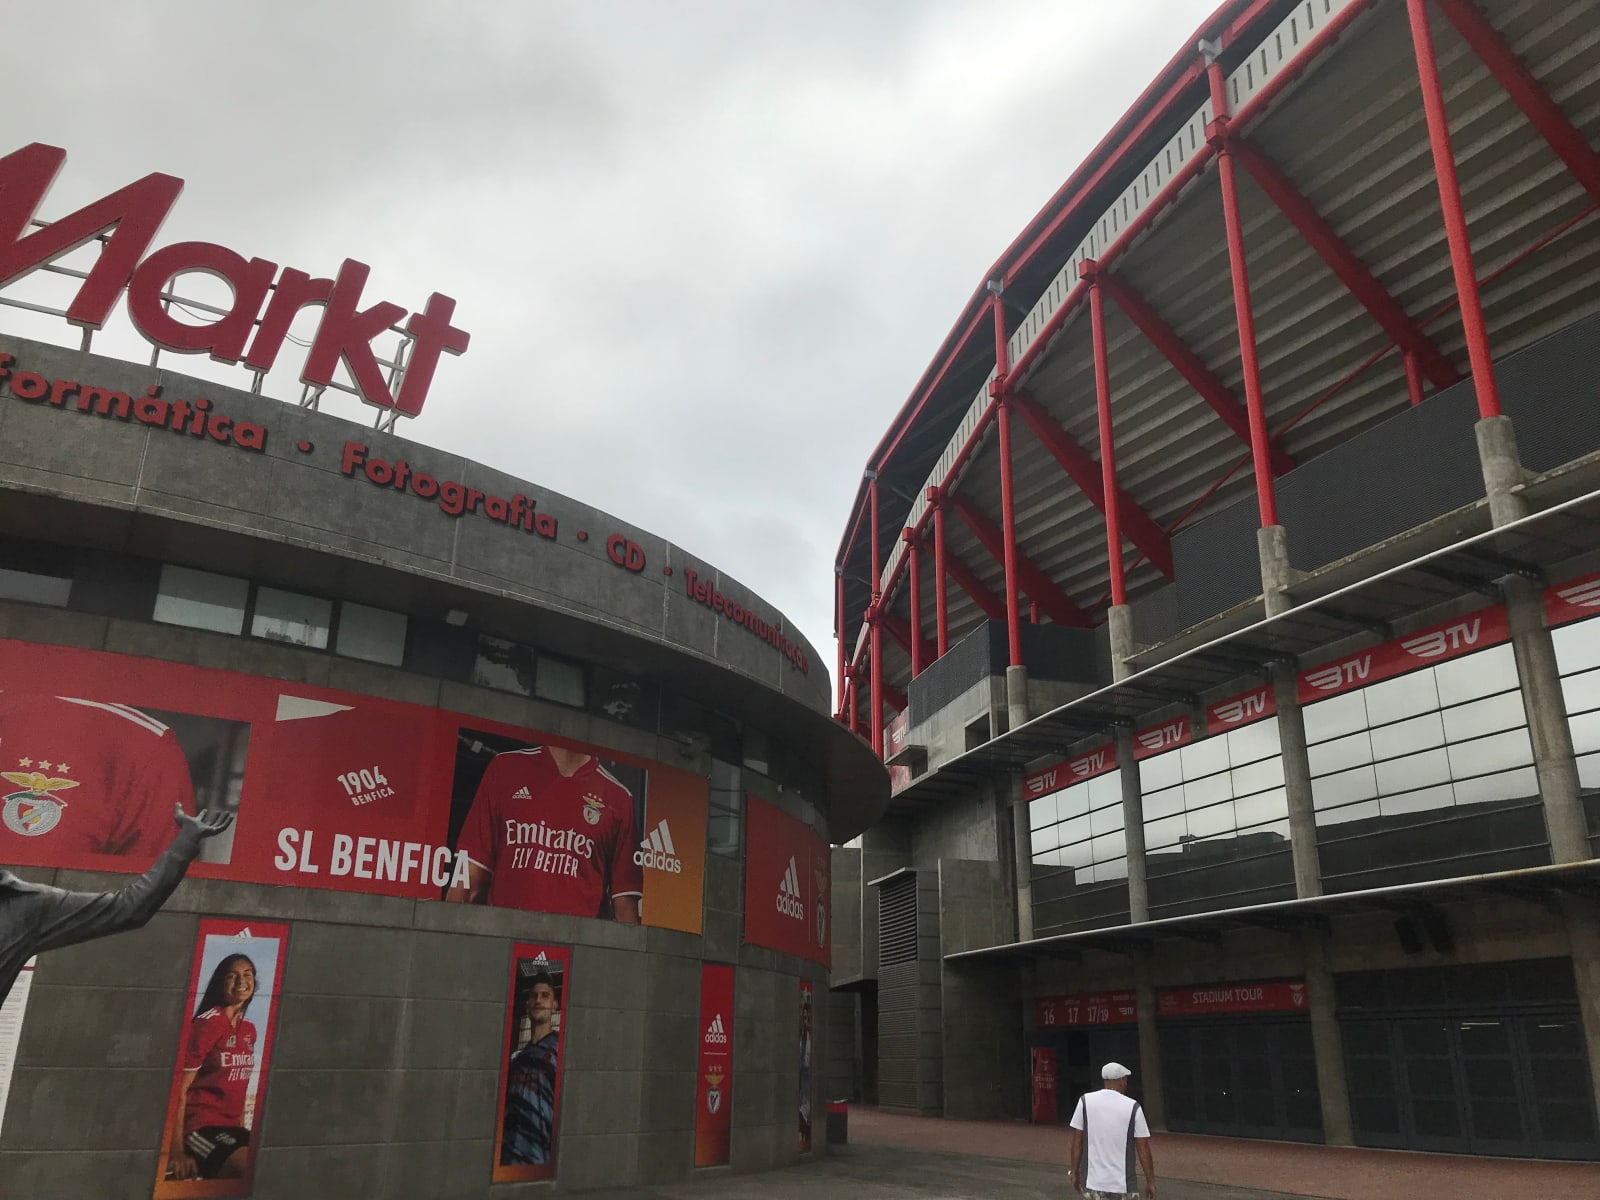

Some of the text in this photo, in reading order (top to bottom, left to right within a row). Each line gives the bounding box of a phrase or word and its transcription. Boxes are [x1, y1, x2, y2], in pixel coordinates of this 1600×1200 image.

[341, 441, 558, 538] Fotografia
[607, 534, 646, 572] CD
[337, 765, 388, 796] 1904
[351, 787, 395, 806] BENFICA
[505, 819, 595, 859] Emirates
[274, 827, 471, 890] SL BENFICA
[511, 847, 579, 878] FLY BETTER
[633, 849, 682, 874] adidas
[776, 892, 804, 920] adidas
[1192, 989, 1232, 1004] STADIUM
[1234, 987, 1263, 1001] TOUR
[1044, 1007, 1055, 1025] 16
[1069, 1007, 1079, 1023] 17
[705, 1032, 727, 1044] adidas
